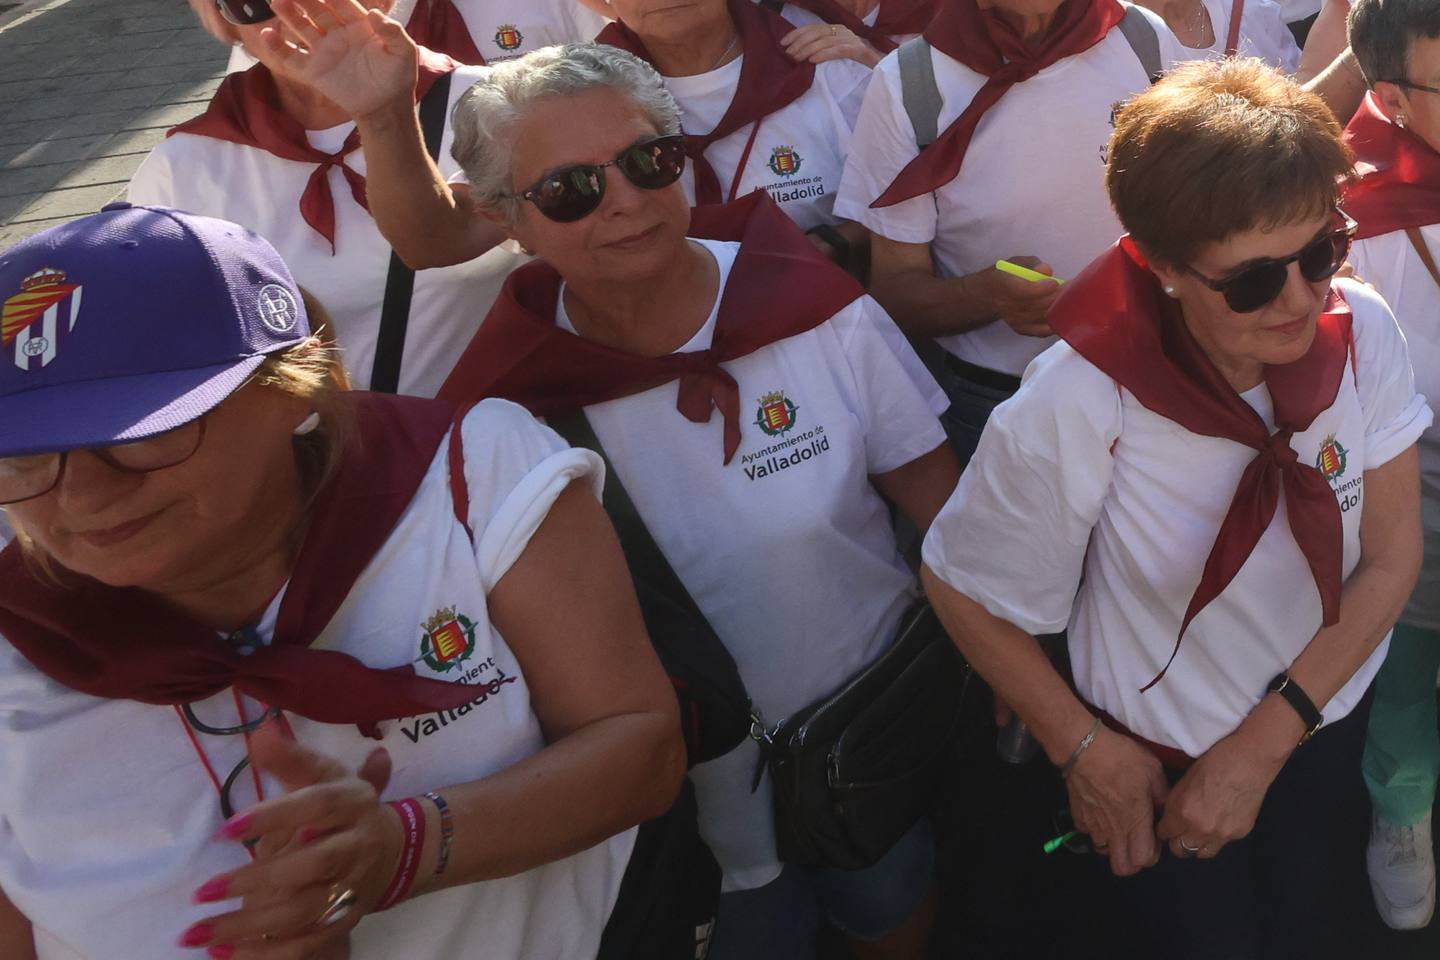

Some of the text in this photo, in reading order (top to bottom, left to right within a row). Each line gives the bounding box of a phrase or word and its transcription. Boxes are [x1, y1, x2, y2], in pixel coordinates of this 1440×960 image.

[741, 425, 824, 464] Ayuntamiento de
[744, 435, 830, 481] Valladolid
